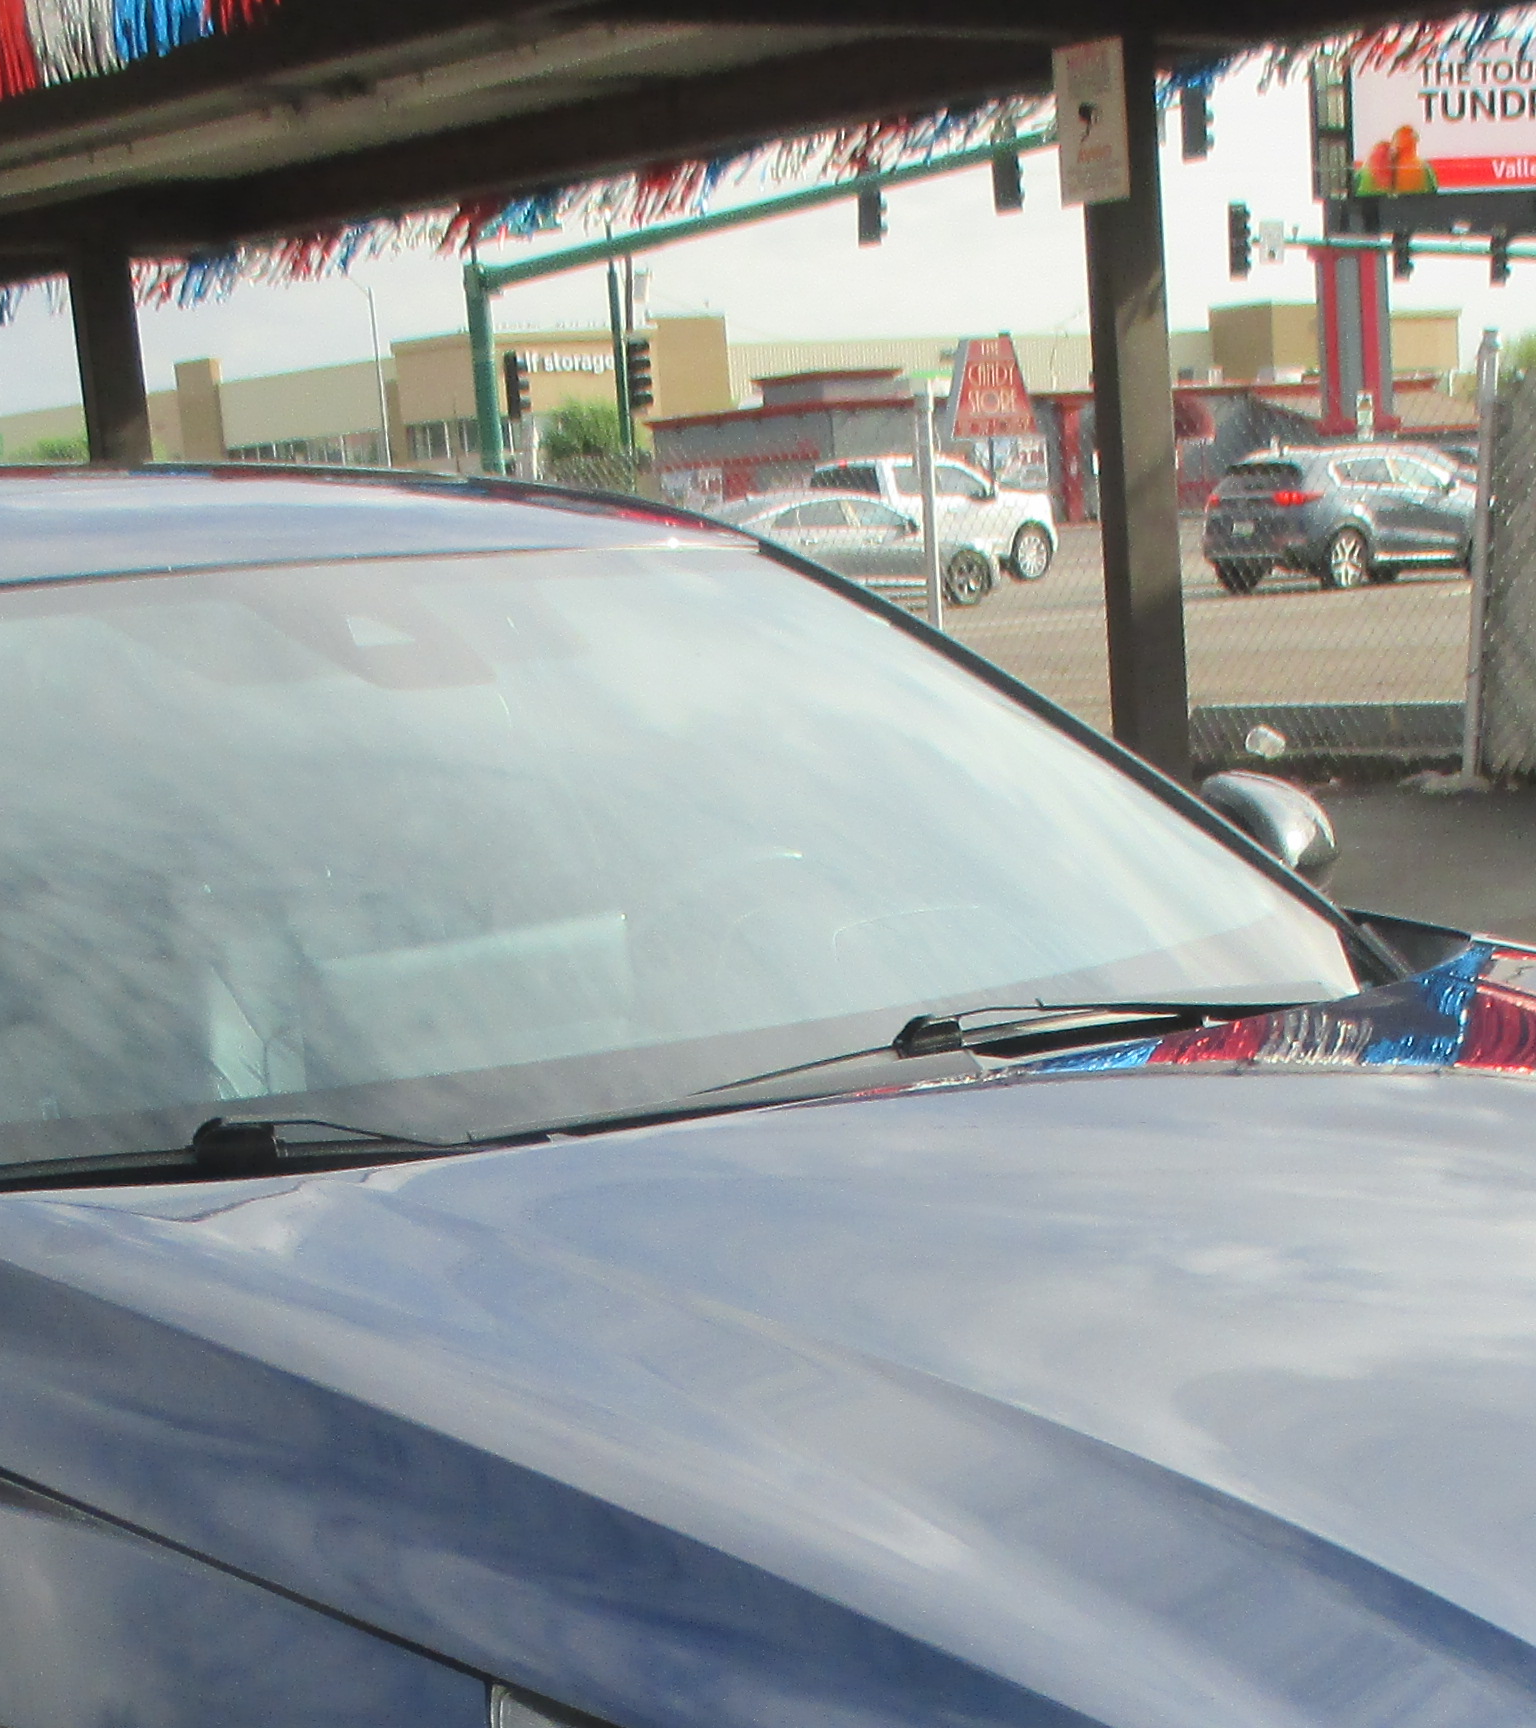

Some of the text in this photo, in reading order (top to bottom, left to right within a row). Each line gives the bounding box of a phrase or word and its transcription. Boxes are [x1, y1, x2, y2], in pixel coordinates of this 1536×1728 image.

[1418, 60, 1471, 87] THE
[968, 361, 1016, 387] CANDY
[968, 388, 1017, 414] STORE
